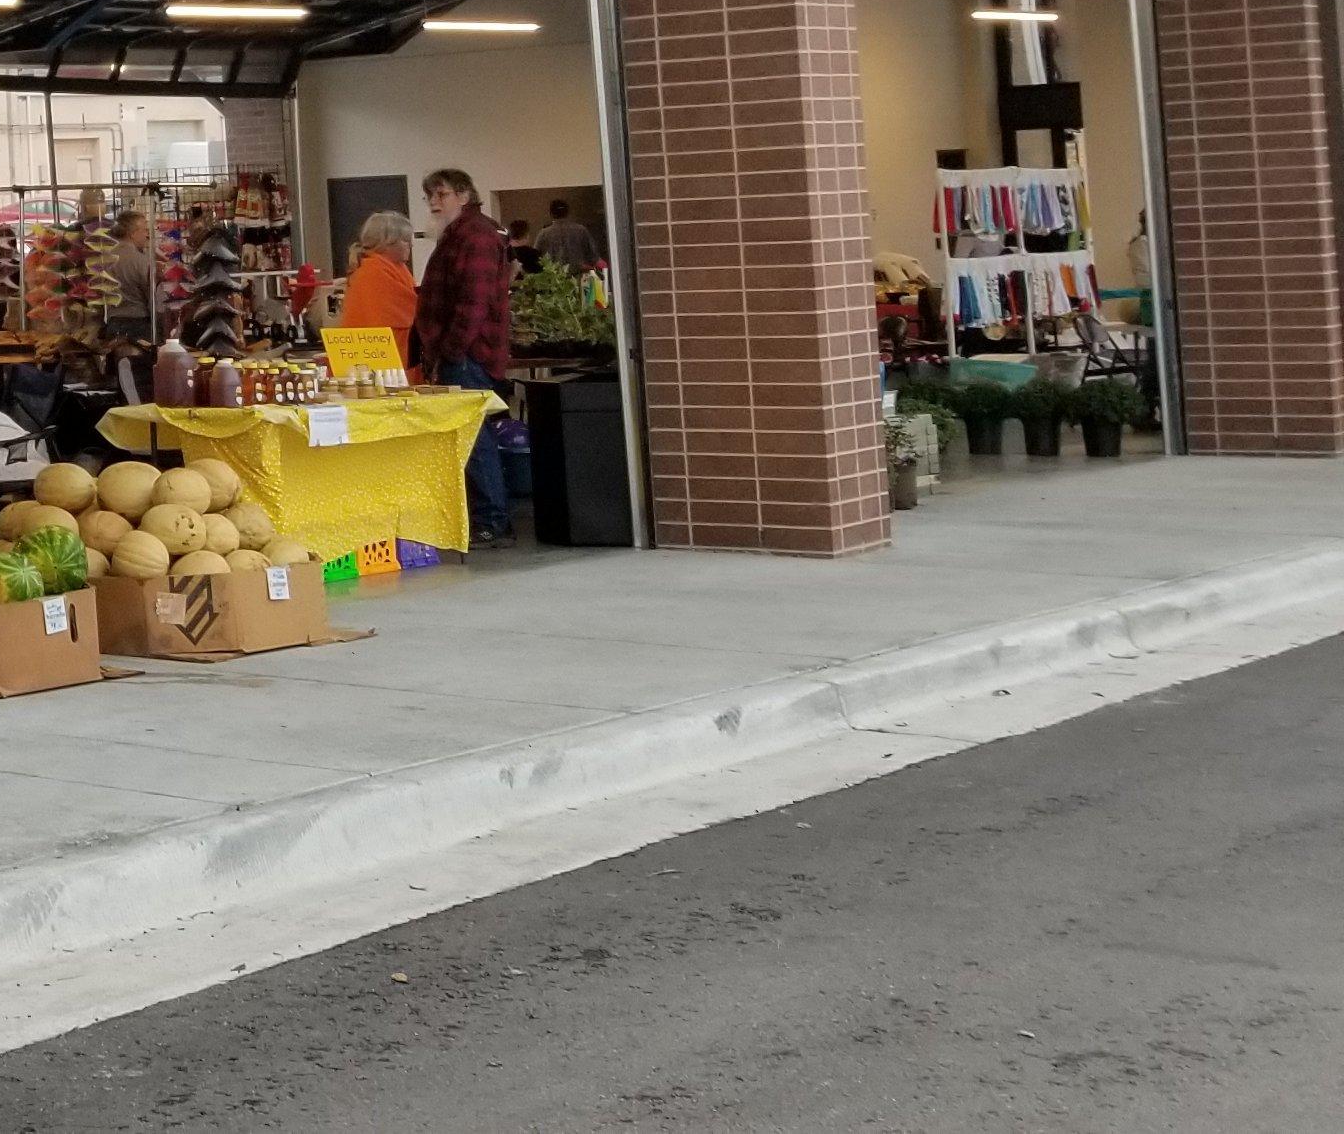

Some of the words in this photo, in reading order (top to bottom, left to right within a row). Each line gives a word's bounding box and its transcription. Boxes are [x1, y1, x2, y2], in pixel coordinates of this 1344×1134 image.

[327, 333, 354, 344] Local
[358, 333, 391, 345] Honey
[340, 349, 359, 359] For
[363, 348, 387, 359] Sale
